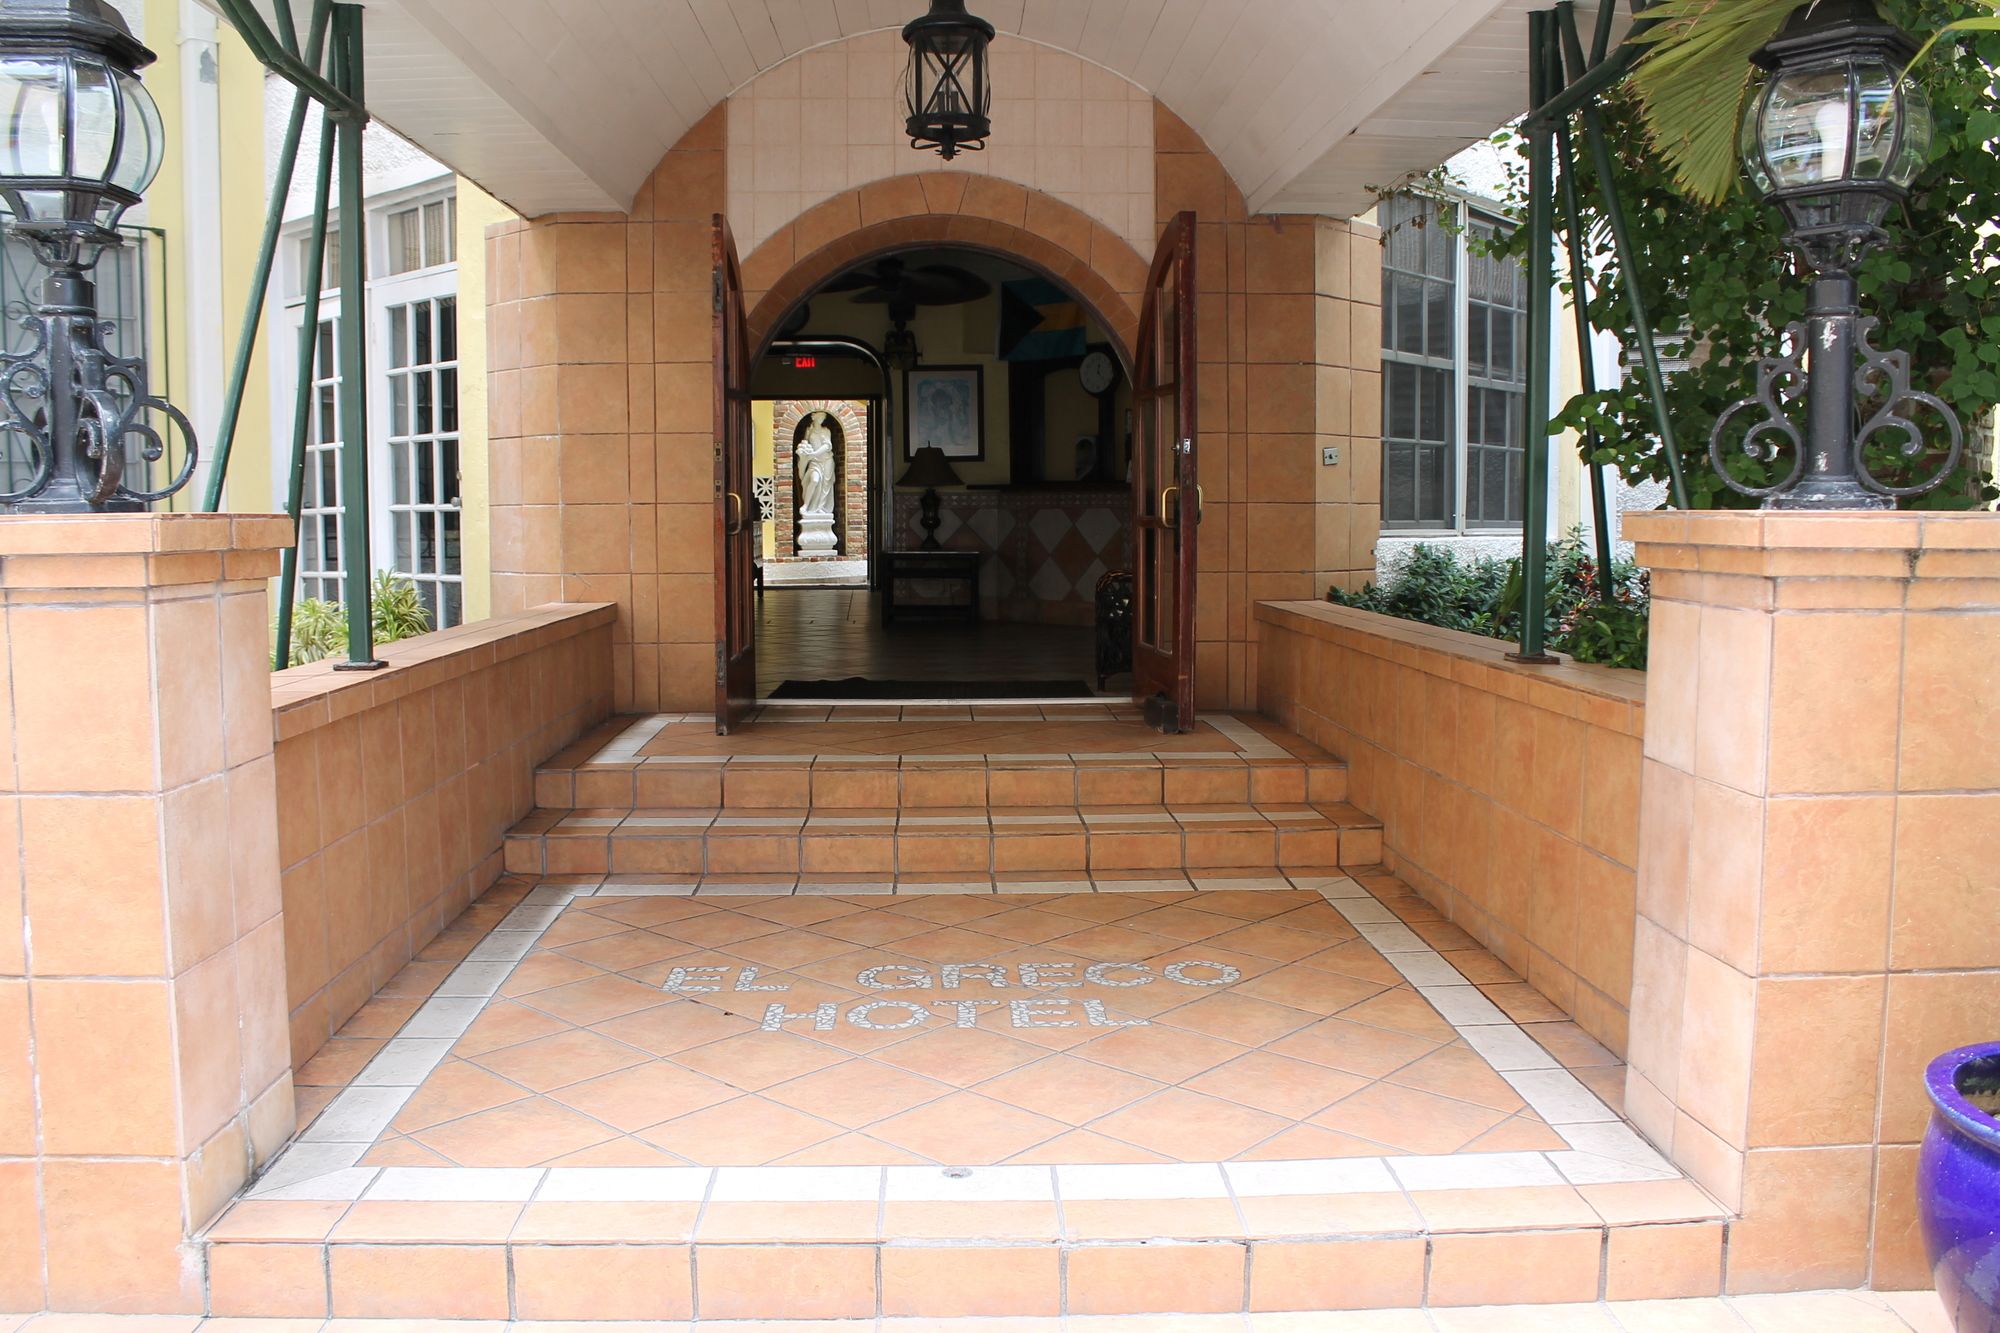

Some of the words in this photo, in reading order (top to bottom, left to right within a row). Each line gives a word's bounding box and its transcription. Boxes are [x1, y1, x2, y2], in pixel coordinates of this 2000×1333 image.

[795, 357, 815, 368] EXIT
[660, 966, 792, 992] EL
[855, 961, 1242, 990] GRECO
[759, 999, 1151, 1031] HOTEL
